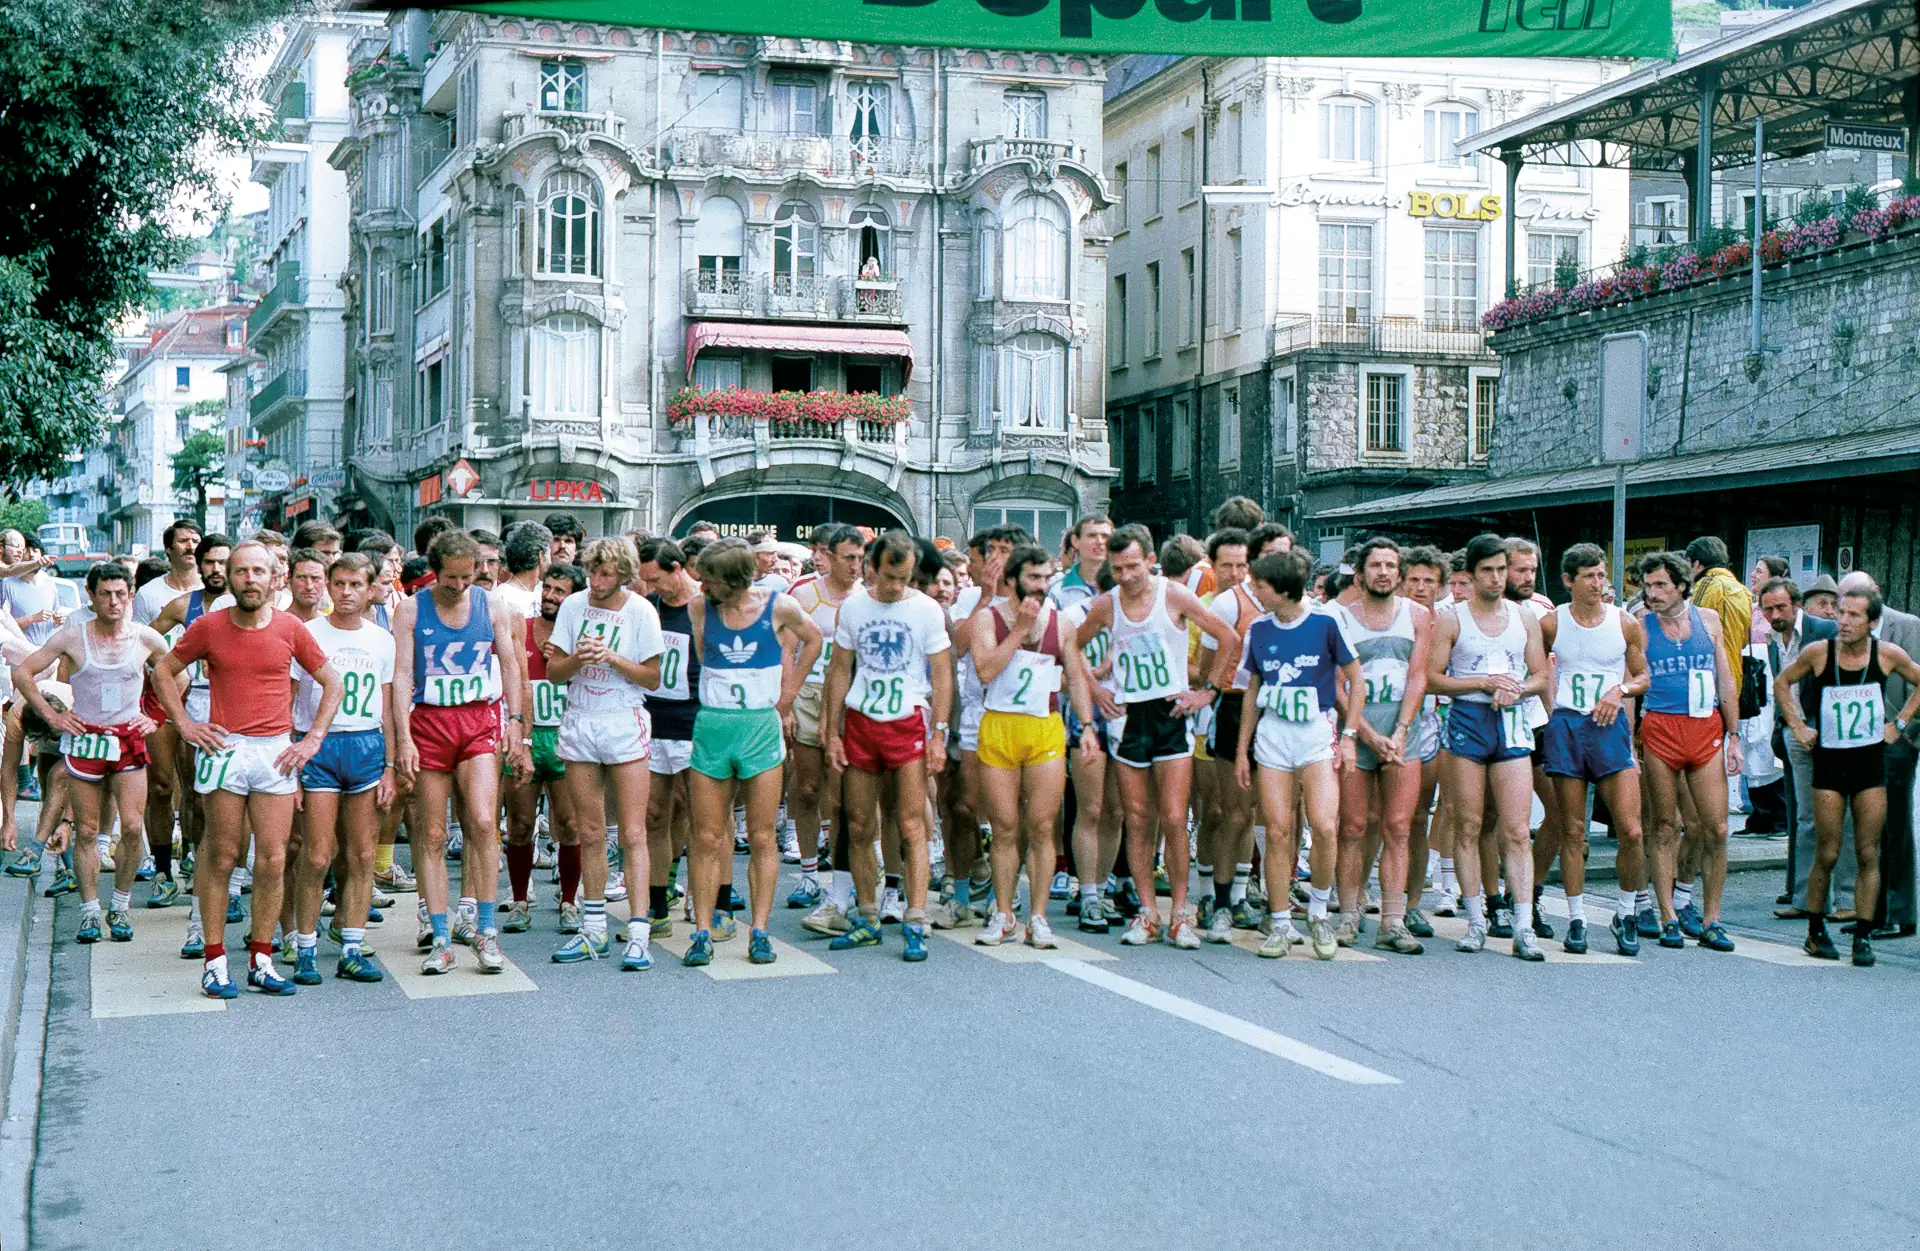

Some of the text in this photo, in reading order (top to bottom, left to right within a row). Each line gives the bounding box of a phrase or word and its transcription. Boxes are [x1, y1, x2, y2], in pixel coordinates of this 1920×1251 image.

[1829, 127, 1902, 150] Montreux
[1407, 191, 1503, 221] BOLS
[1514, 194, 1602, 227] Gins
[530, 480, 604, 501] LIPKA
[1013, 667, 1033, 705] 2
[1118, 650, 1170, 693] 268
[342, 671, 376, 718] 82
[434, 676, 483, 707] 102
[860, 677, 904, 715] 126
[1571, 673, 1605, 709] 67
[1695, 672, 1705, 709] 1
[1832, 700, 1876, 741] 121
